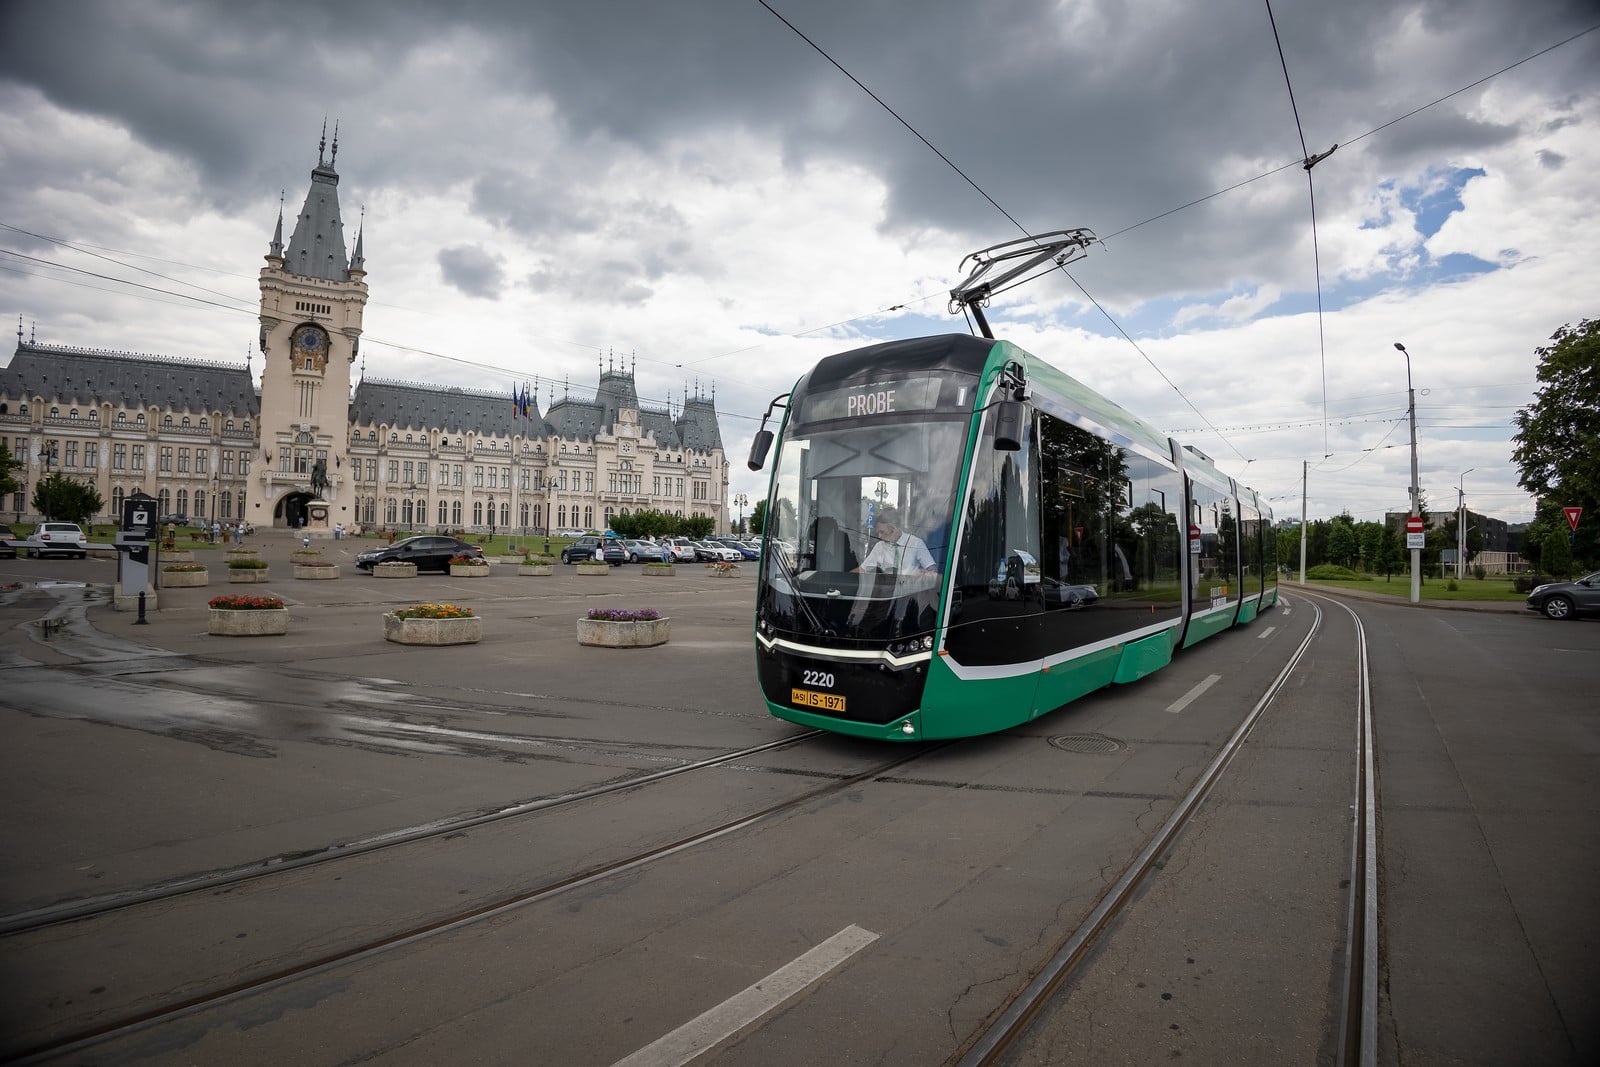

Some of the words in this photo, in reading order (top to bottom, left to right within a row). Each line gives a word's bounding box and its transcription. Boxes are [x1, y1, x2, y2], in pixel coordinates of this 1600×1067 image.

[847, 390, 896, 417] PROBE
[803, 670, 835, 688] 2220
[809, 693, 844, 710] IS-1971
